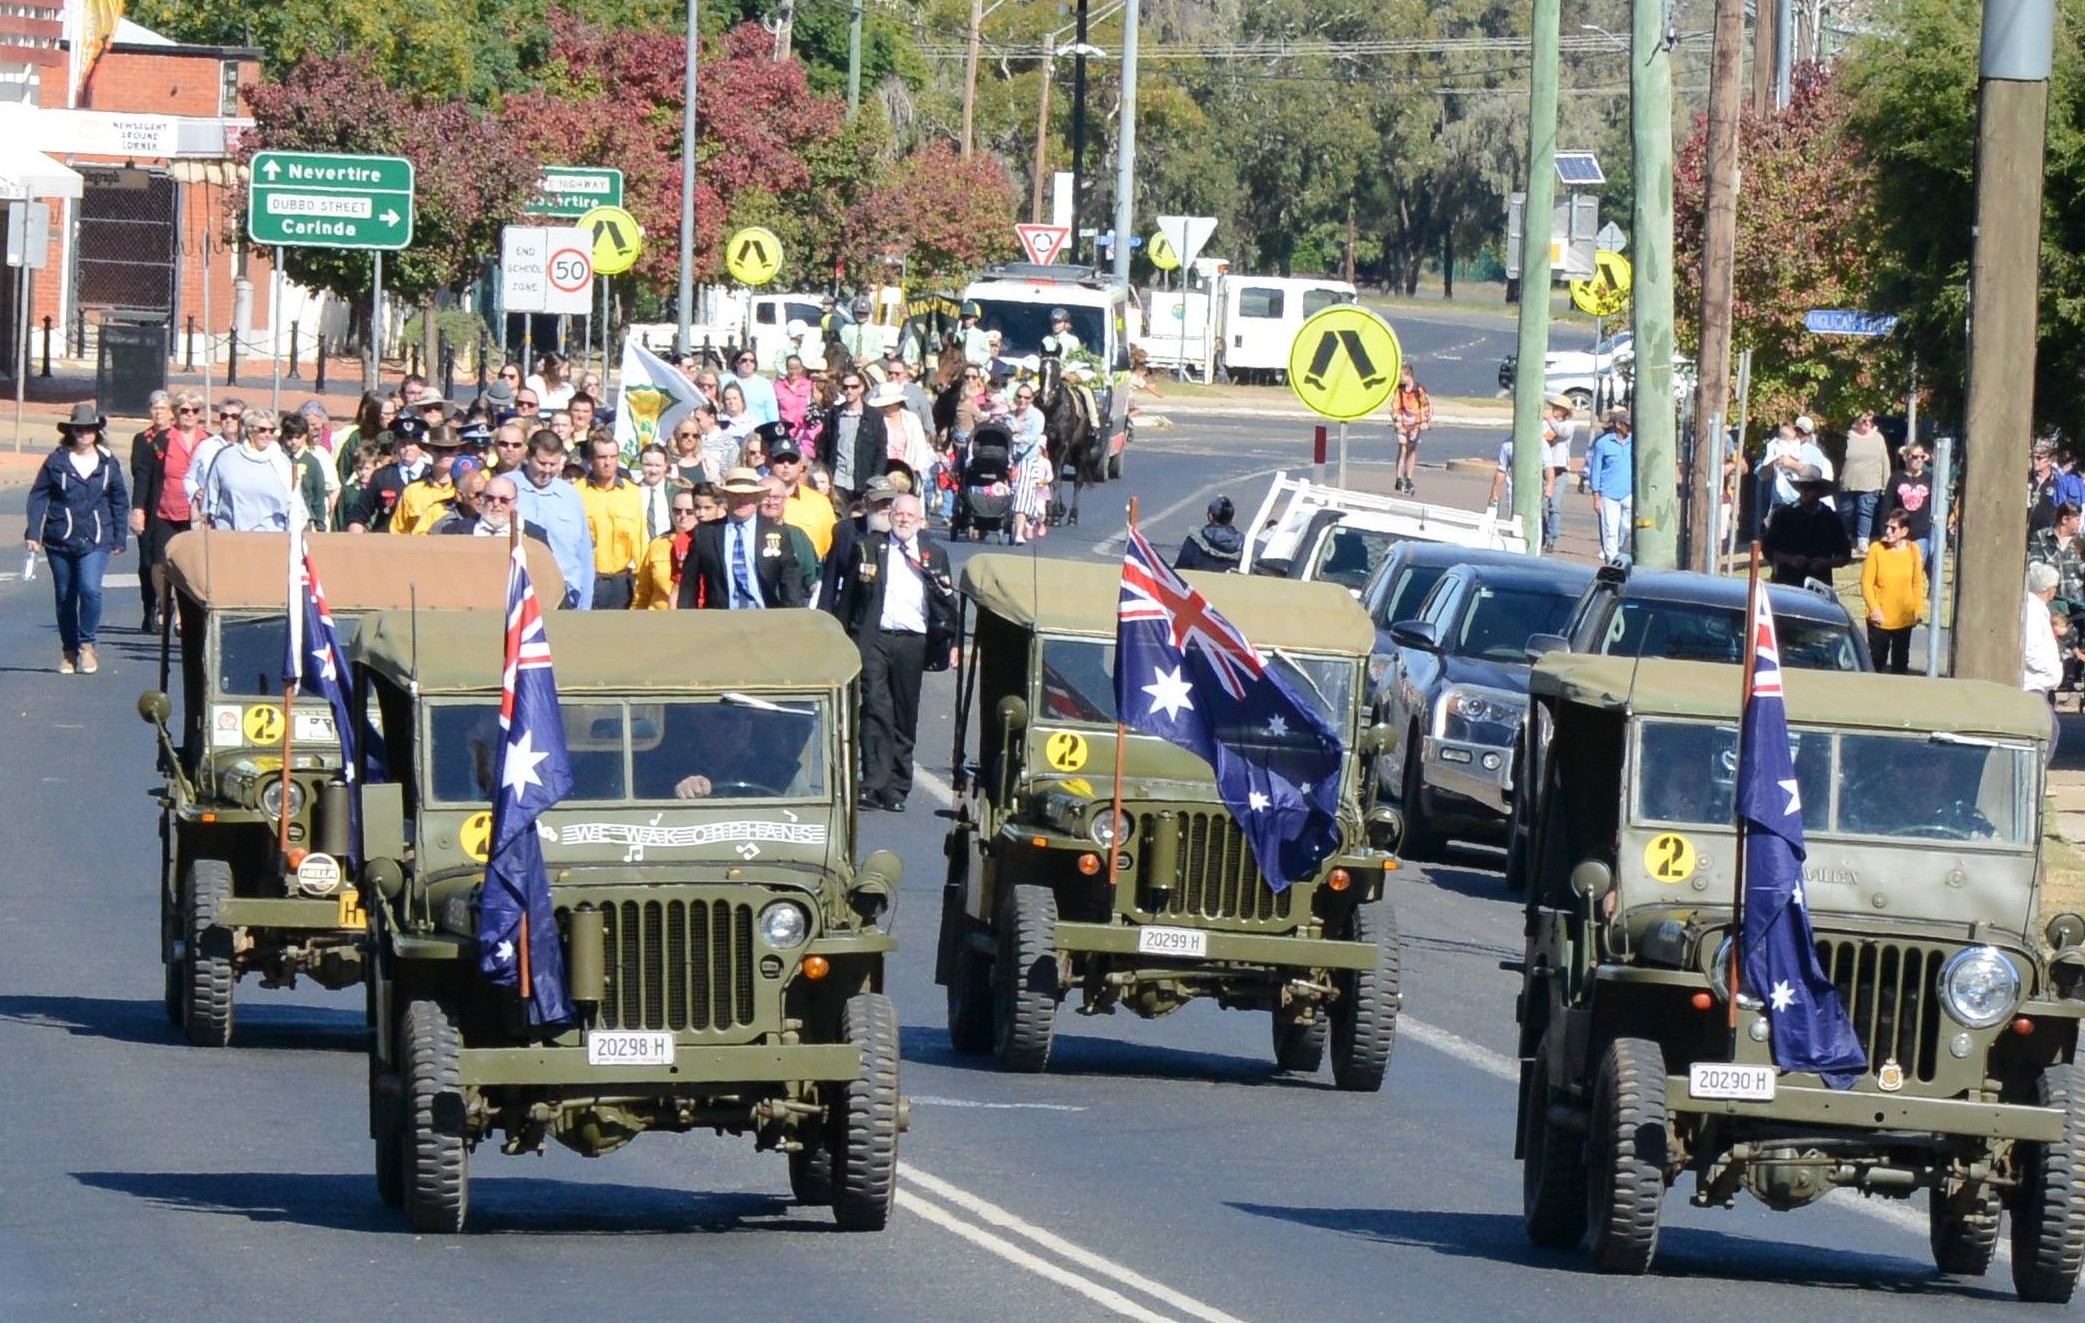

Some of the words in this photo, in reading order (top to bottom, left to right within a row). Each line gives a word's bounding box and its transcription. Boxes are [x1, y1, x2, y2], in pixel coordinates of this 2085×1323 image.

[121, 131, 159, 141] AROUND
[288, 163, 382, 183] Nevertire
[272, 198, 315, 211] DUBBO
[320, 200, 366, 213] STREET
[281, 218, 357, 236] Carinda
[515, 247, 536, 256] END
[507, 264, 543, 274] SCHOOL
[555, 260, 585, 281] 50
[512, 282, 539, 292] ZONE
[253, 707, 276, 740] 2
[1056, 733, 1079, 767] 2
[574, 824, 610, 843] WE
[693, 821, 814, 843] ORPHANS
[1657, 835, 1684, 877] 2
[1146, 931, 1187, 949] 20299
[1191, 935, 1200, 950] H
[597, 1037, 648, 1057] 20298
[654, 1037, 665, 1056] H
[1699, 1070, 1751, 1090] 20290
[1756, 1072, 1766, 1091] H
